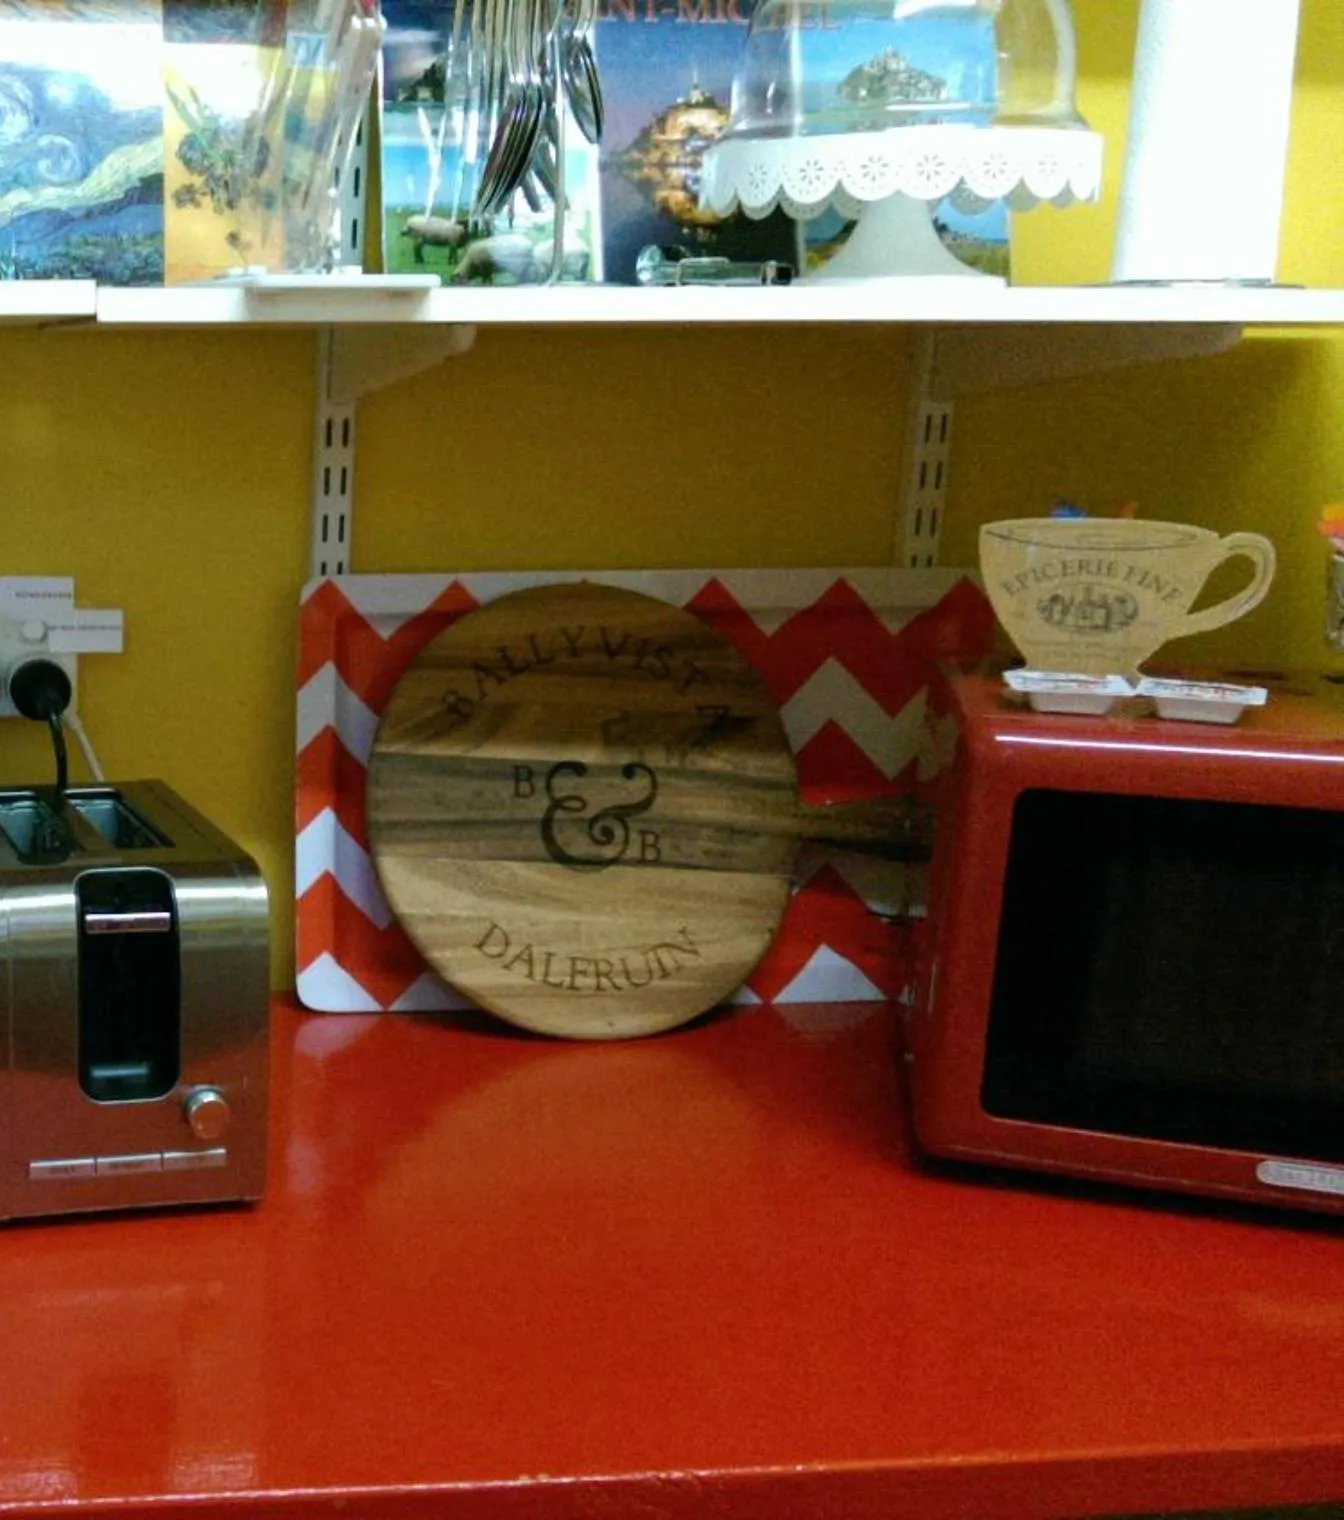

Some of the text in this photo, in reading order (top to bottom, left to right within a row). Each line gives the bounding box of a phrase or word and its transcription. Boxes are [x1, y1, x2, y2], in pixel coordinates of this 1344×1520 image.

[1001, 558, 1183, 603] EPICERIE FINE
[472, 920, 702, 992] DALFRUIN
